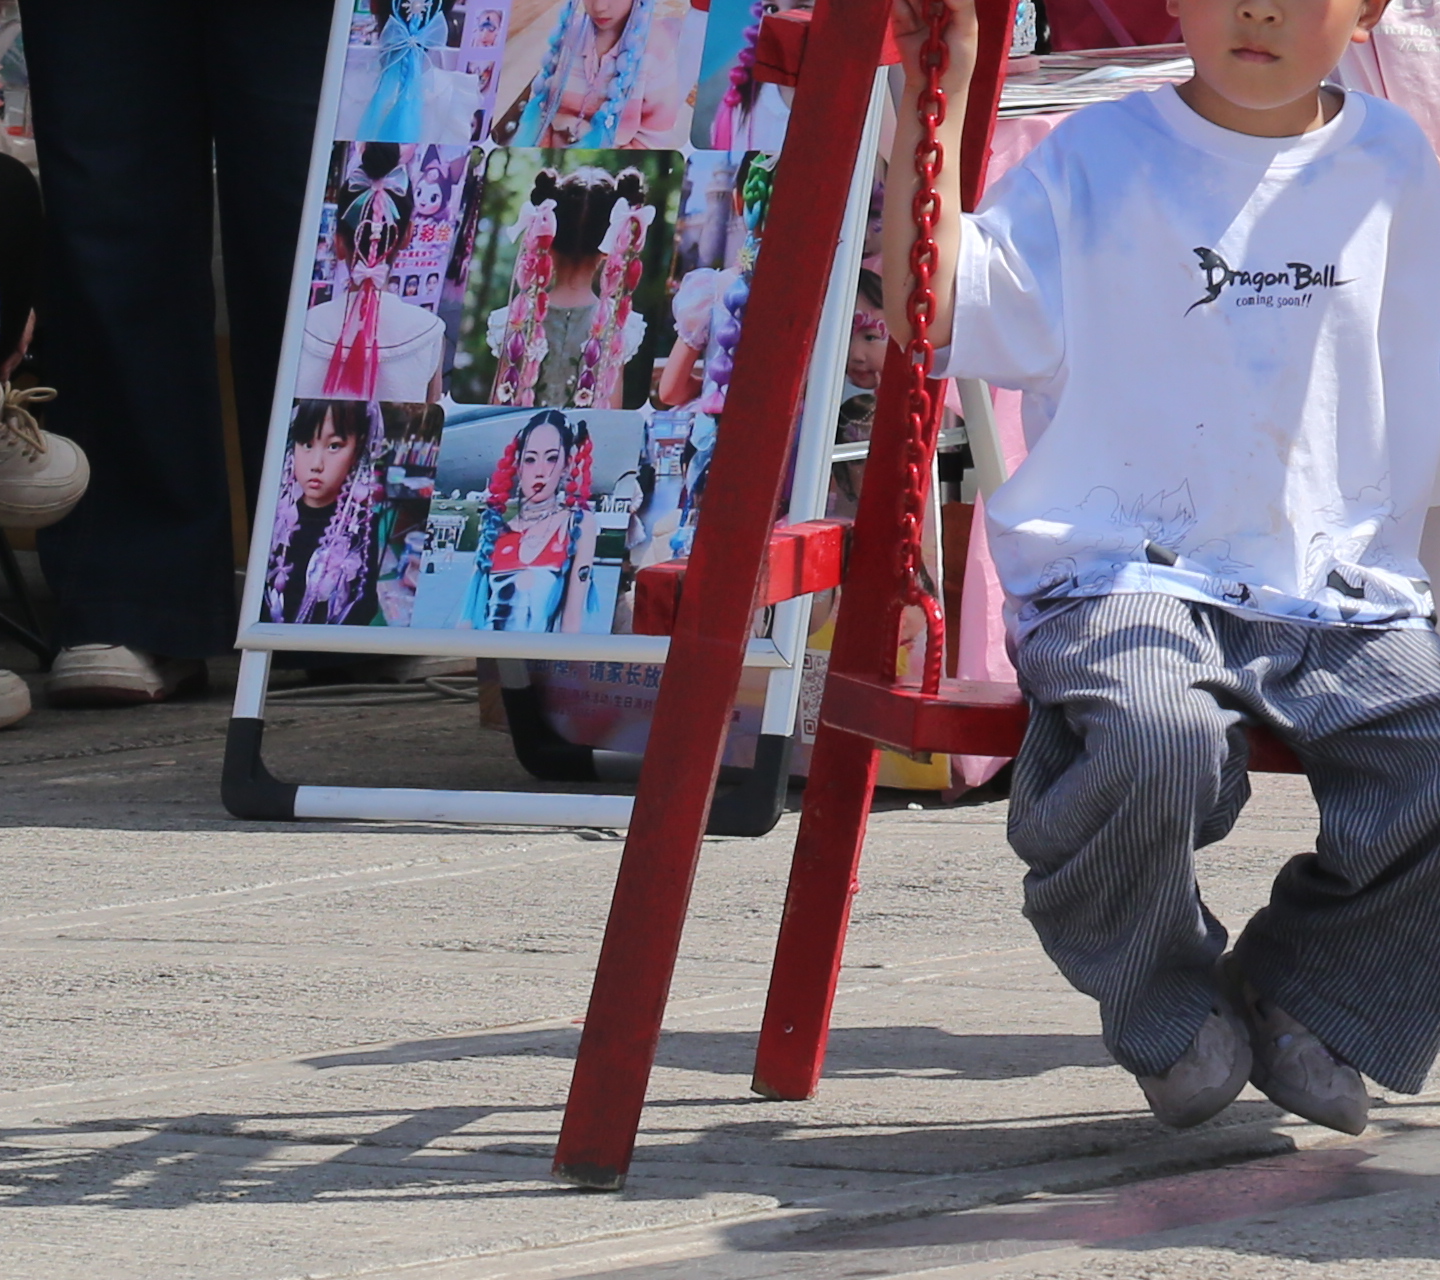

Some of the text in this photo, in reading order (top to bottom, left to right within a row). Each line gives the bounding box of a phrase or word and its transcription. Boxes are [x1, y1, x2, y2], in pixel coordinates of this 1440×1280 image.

[1184, 246, 1359, 317] Dragon Ball
[1236, 293, 1313, 308] coming soon!!
